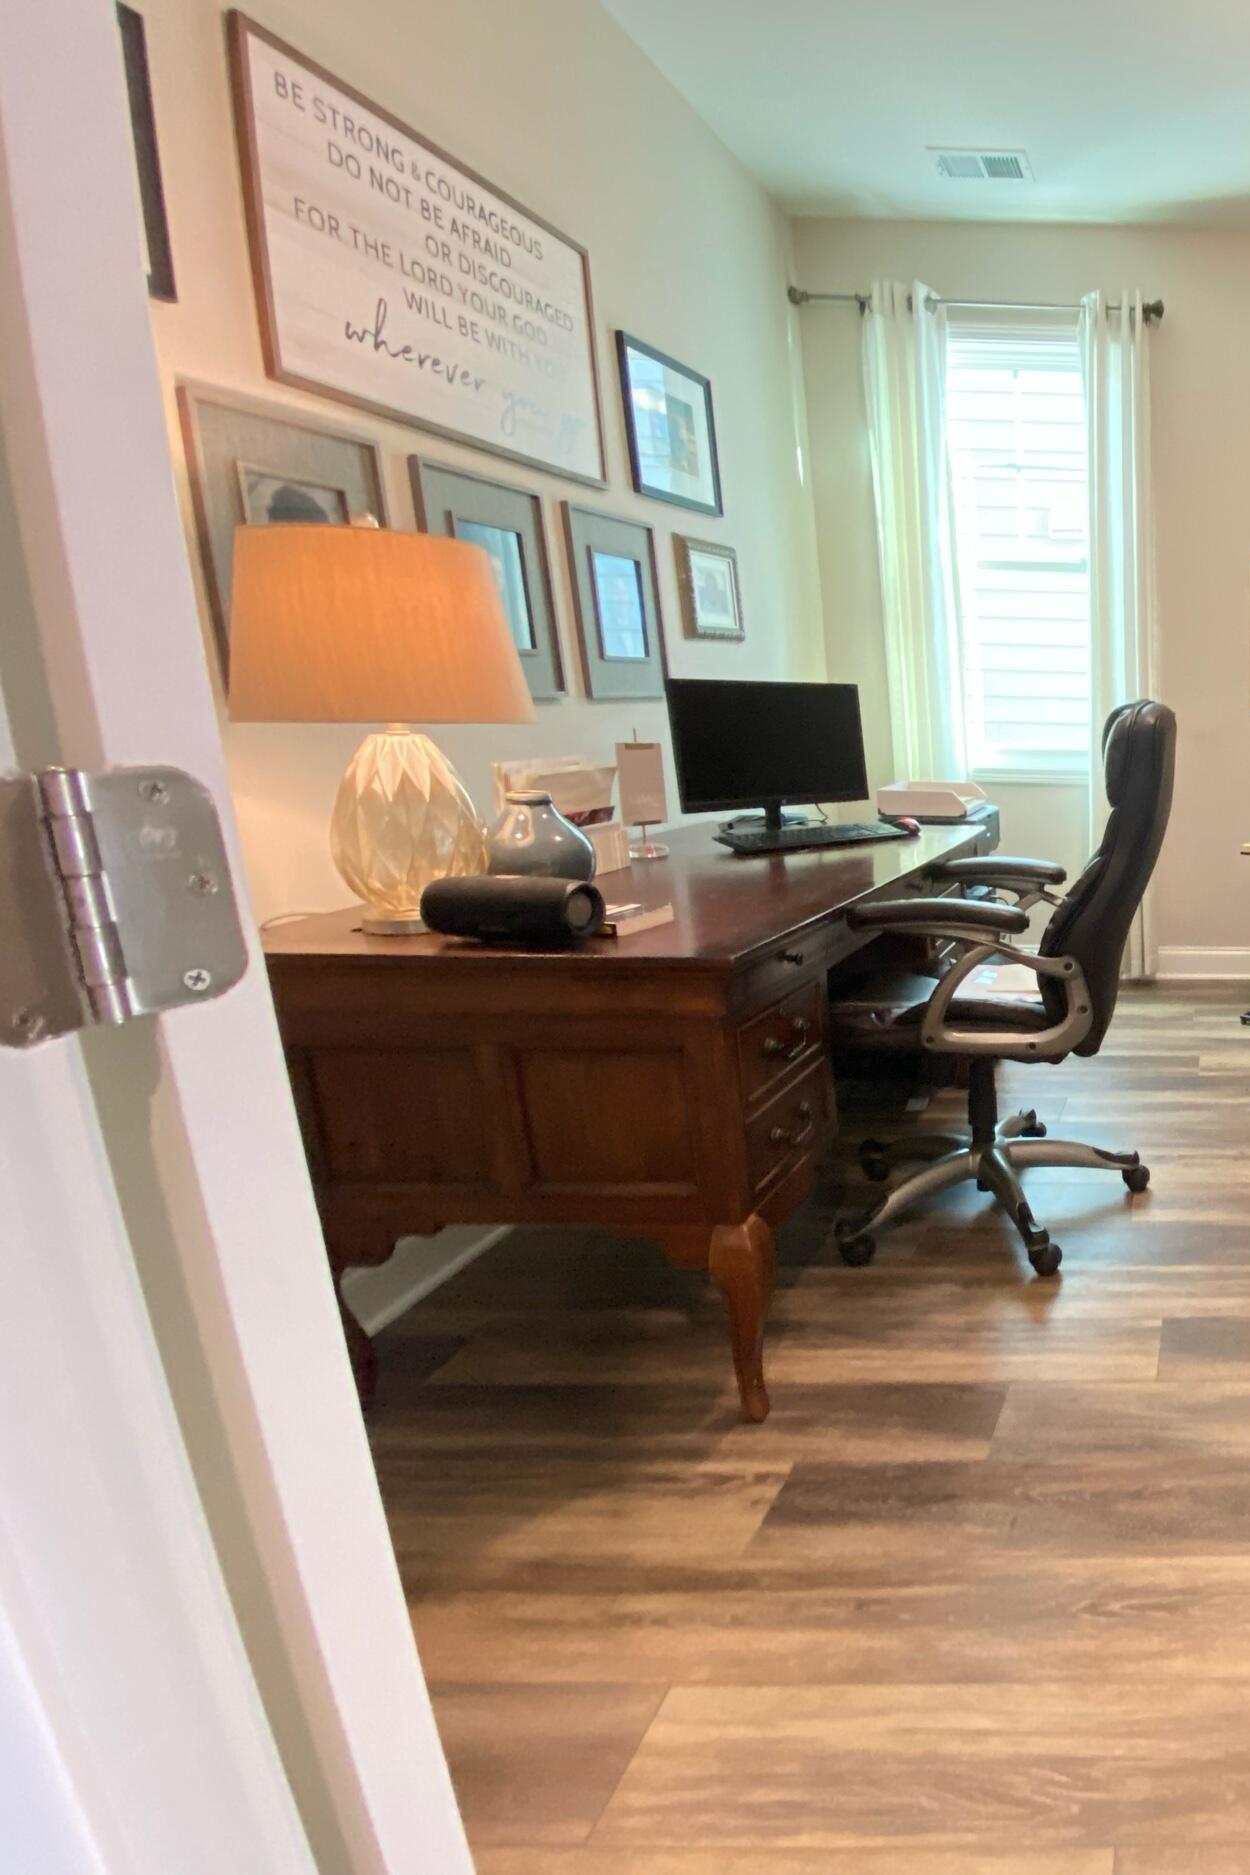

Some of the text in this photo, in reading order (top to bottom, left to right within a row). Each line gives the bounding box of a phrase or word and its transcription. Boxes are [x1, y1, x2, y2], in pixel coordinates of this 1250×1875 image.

[274, 71, 544, 261] BE STRONG & COURAGEOUS
[327, 140, 512, 268] DO NOT BE AFRAID
[293, 196, 548, 347] FOR THE LORD YOUR GOD
[402, 287, 454, 331] WILL
[457, 315, 482, 344] BE
[484, 328, 531, 367] WITH
[425, 234, 574, 332] OR DISCOURAGED
[344, 297, 488, 393] wherever
